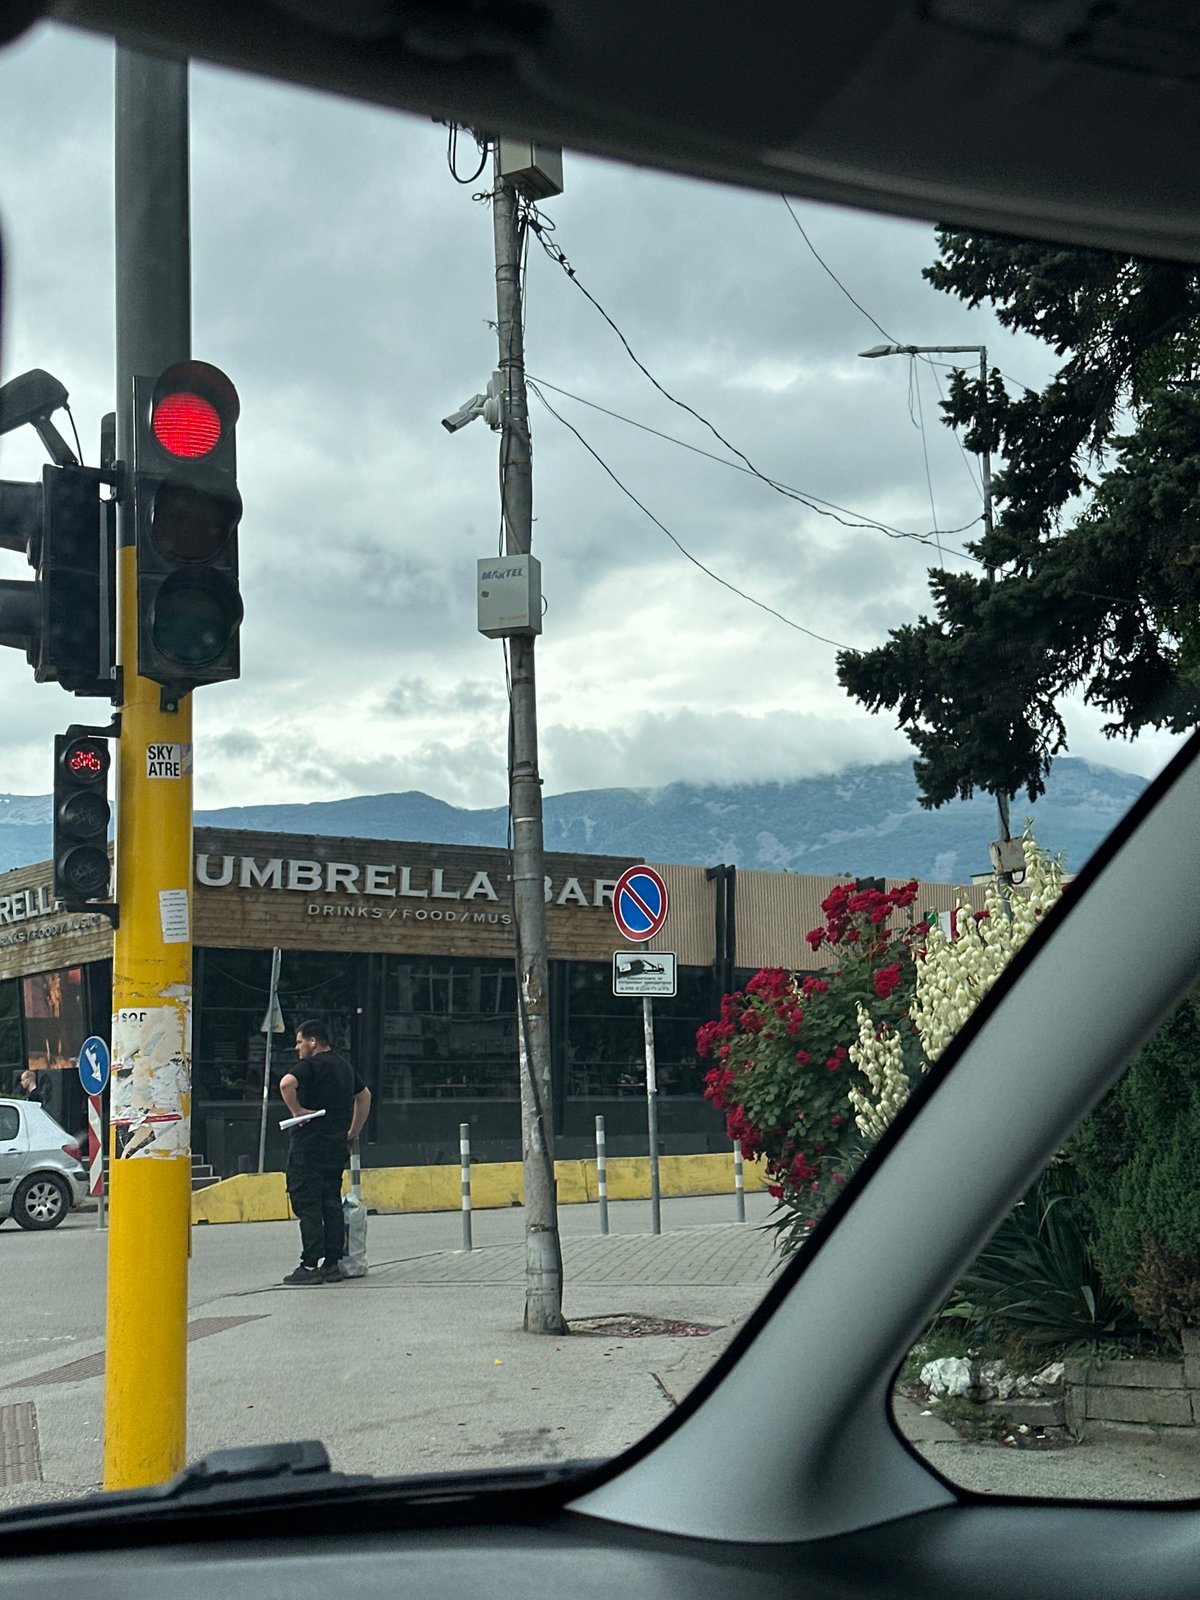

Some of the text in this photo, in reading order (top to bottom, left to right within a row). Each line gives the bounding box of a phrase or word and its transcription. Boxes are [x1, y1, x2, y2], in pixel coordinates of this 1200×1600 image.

[148, 745, 173, 760] SKY
[148, 761, 180, 777] ATRE
[195, 853, 617, 907] UMBRELLA AR
[307, 904, 513, 925] DRINKS/FOOD/MUS
